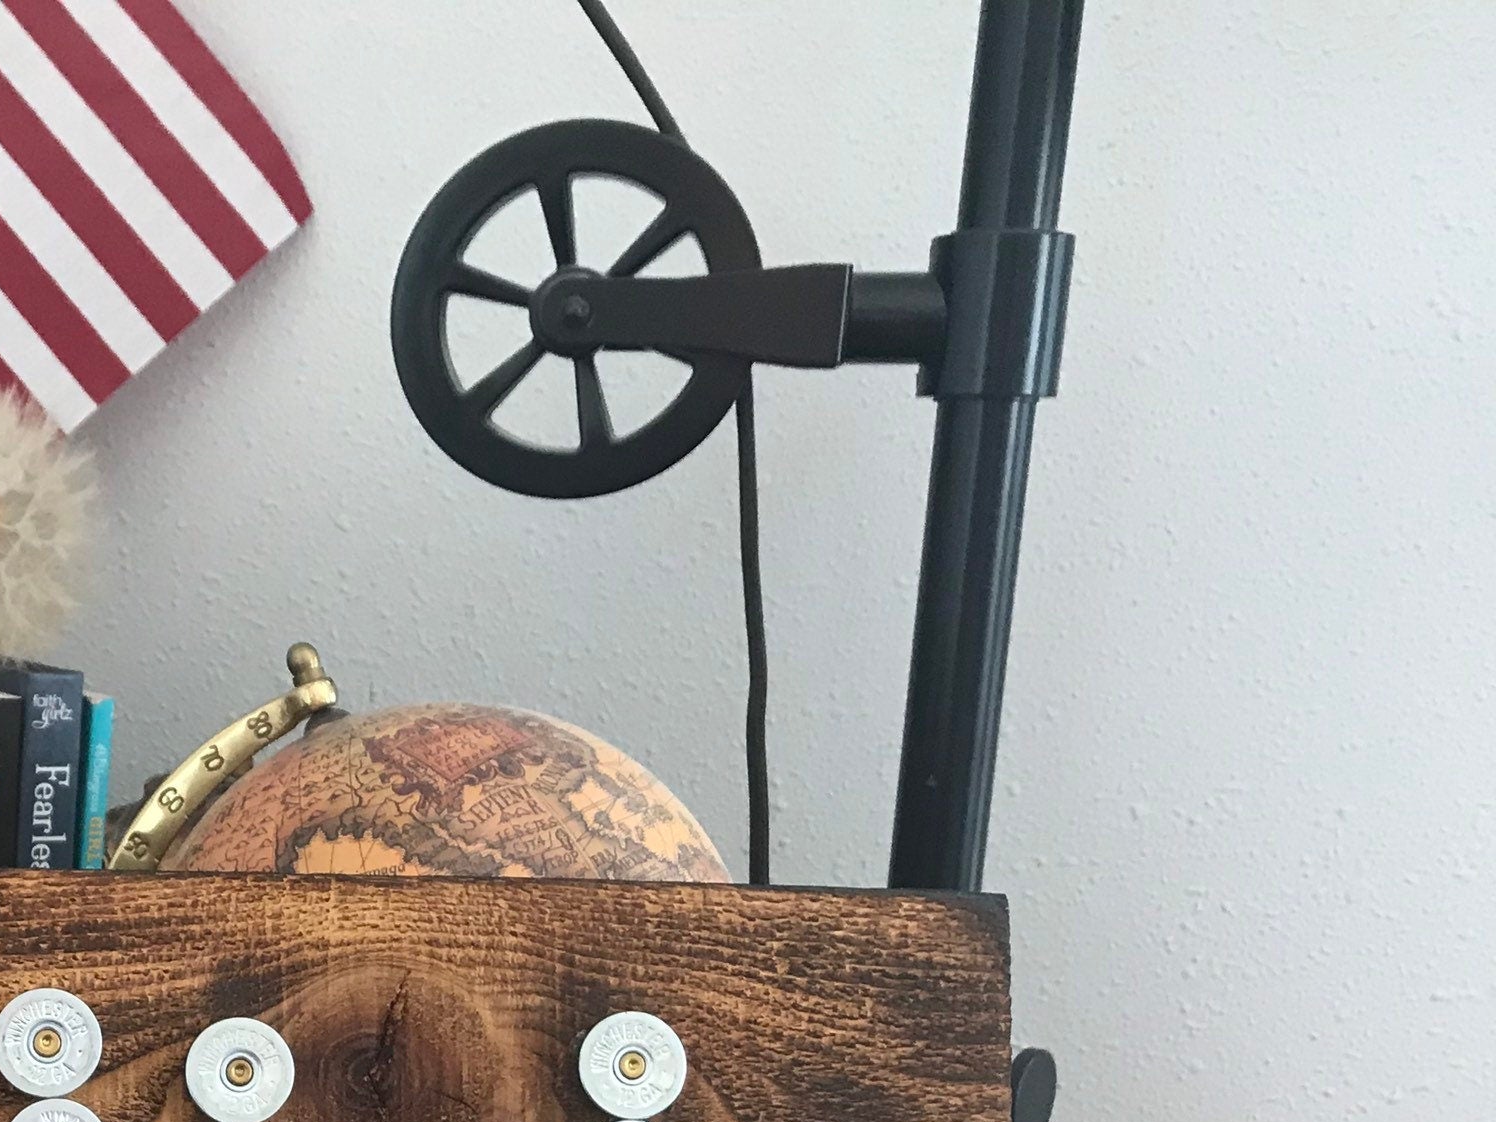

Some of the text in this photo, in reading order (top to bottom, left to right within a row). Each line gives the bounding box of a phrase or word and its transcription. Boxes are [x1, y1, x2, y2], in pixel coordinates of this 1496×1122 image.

[246, 711, 273, 739] 80
[200, 744, 225, 772] 70
[158, 786, 185, 814] 60
